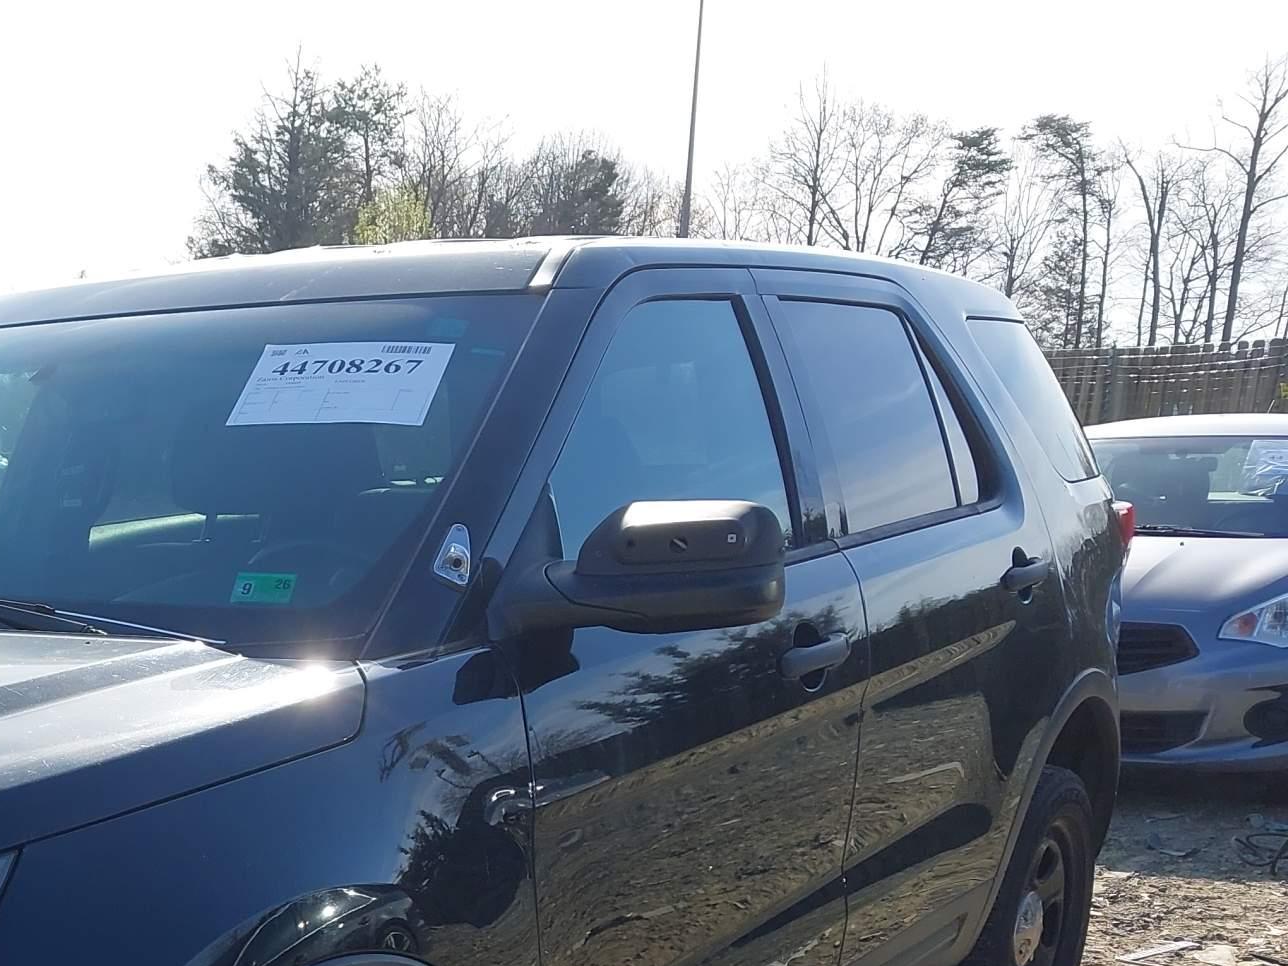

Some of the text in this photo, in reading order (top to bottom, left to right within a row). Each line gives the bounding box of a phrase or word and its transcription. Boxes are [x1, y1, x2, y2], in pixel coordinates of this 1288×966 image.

[272, 358, 424, 376] 44708267
[241, 578, 290, 595] 9 26
